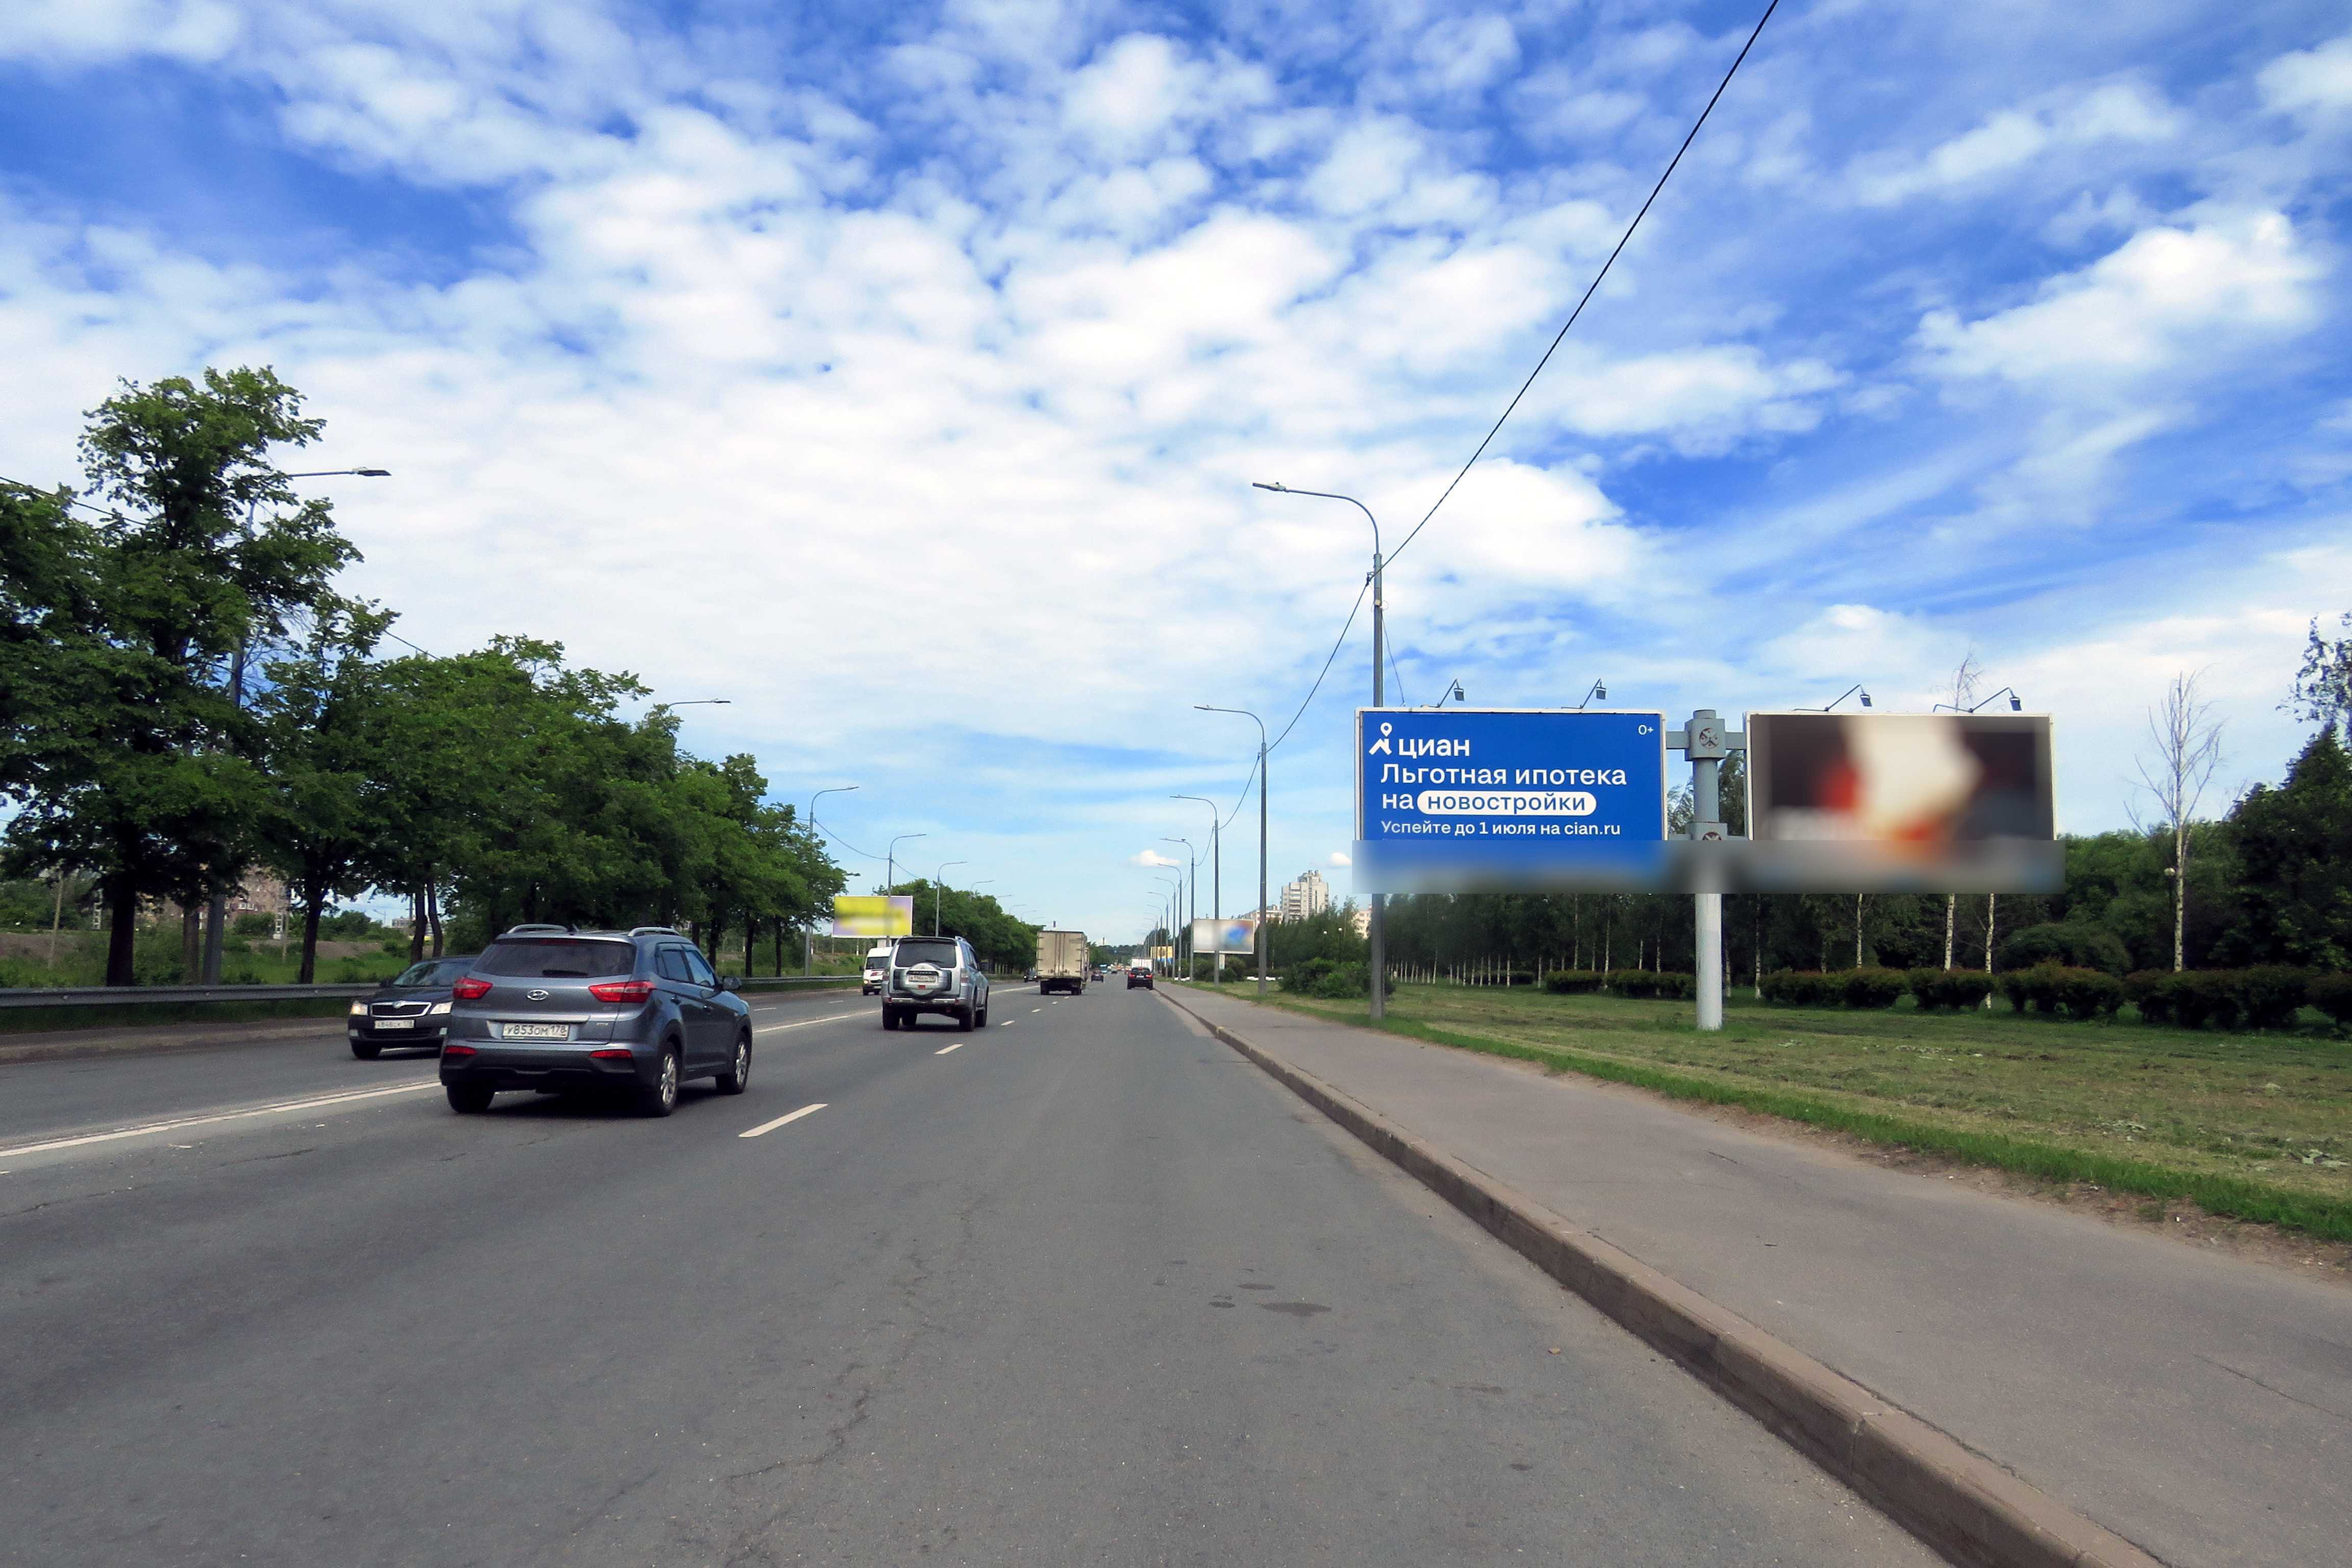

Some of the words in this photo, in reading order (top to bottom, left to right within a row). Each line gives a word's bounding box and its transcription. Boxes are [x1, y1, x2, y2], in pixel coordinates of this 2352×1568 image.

[1638, 724, 1654, 735] 0+
[1399, 739, 1470, 759] циан
[1381, 764, 1507, 785] Льготная
[1515, 769, 1627, 785] ипотека
[1382, 793, 1414, 810] на
[1428, 792, 1585, 814] новостройки
[1382, 821, 1451, 834] Успейте
[1454, 824, 1475, 836] до
[1479, 822, 1488, 834] 1
[1492, 824, 1536, 835] июля
[1540, 824, 1560, 835] на
[1564, 822, 1620, 835] cian.ru
